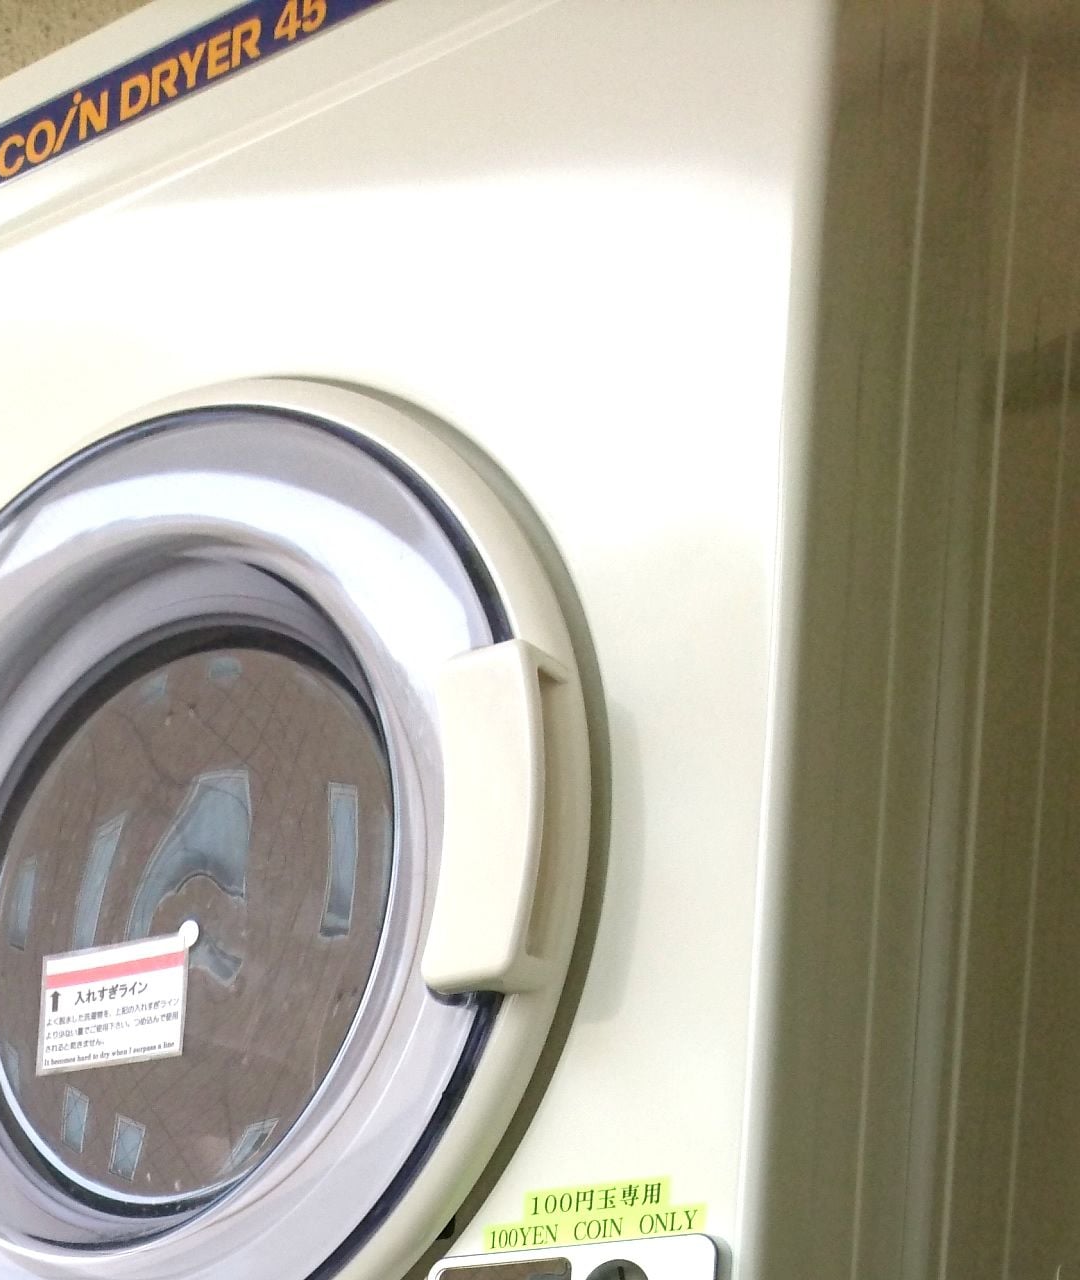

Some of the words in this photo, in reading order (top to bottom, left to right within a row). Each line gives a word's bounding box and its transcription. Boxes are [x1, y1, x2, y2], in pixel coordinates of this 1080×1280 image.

[121, 19, 261, 120] DRYER
[273, 0, 327, 43] 45
[75, 982, 148, 1005] 入れすぎライン
[531, 1182, 662, 1216] 100円玉専用
[489, 1225, 559, 1250] 100YEN
[574, 1218, 623, 1243] COIN
[640, 1209, 698, 1235] ONLY
